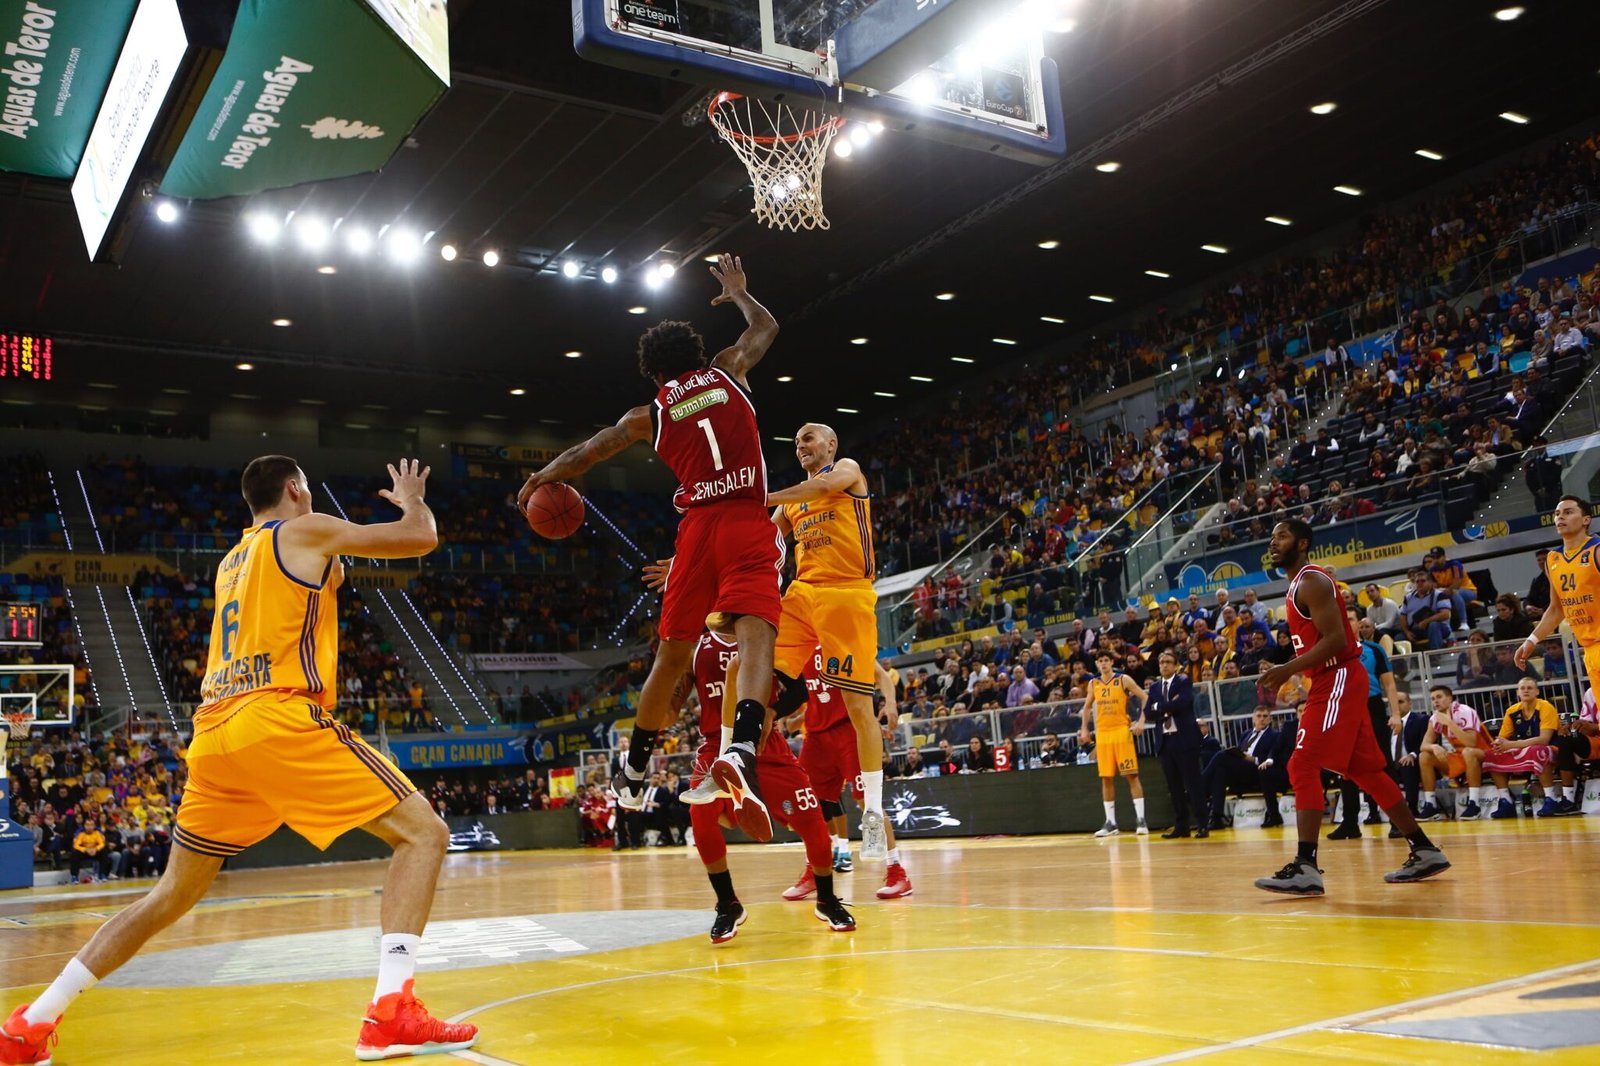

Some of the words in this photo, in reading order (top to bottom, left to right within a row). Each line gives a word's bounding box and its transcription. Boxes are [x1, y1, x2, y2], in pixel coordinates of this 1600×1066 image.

[624, 4, 646, 17] one
[646, 8, 676, 24] team
[5, 1, 57, 58] Teror
[1, 60, 43, 87] de
[54, 47, 81, 117] www.aguasdeteror.com
[263, 55, 314, 113] Aguas
[0, 87, 39, 139] Aguas
[986, 99, 1014, 114] EuroCup
[242, 112, 281, 135] de
[221, 135, 271, 169] Teror
[697, 417, 724, 471] 1
[1541, 511, 1555, 527] GR
[1354, 551, 1372, 563] GRAN
[1374, 545, 1403, 559] CANARIA
[75, 560, 102, 571] GRAN
[75, 573, 118, 584] CANARIA
[1560, 573, 1576, 592] 24
[1560, 594, 1594, 606] ERBALIFE
[221, 599, 240, 662] 6
[253, 652, 272, 674] DE
[814, 654, 823, 671] 8
[841, 654, 854, 677] 4
[1102, 688, 1111, 698] 21
[411, 745, 445, 763] GRAN
[451, 742, 504, 762] CANARIA
[995, 749, 1007, 766] 5
[855, 774, 865, 792] 8
[795, 787, 818, 811] 55
